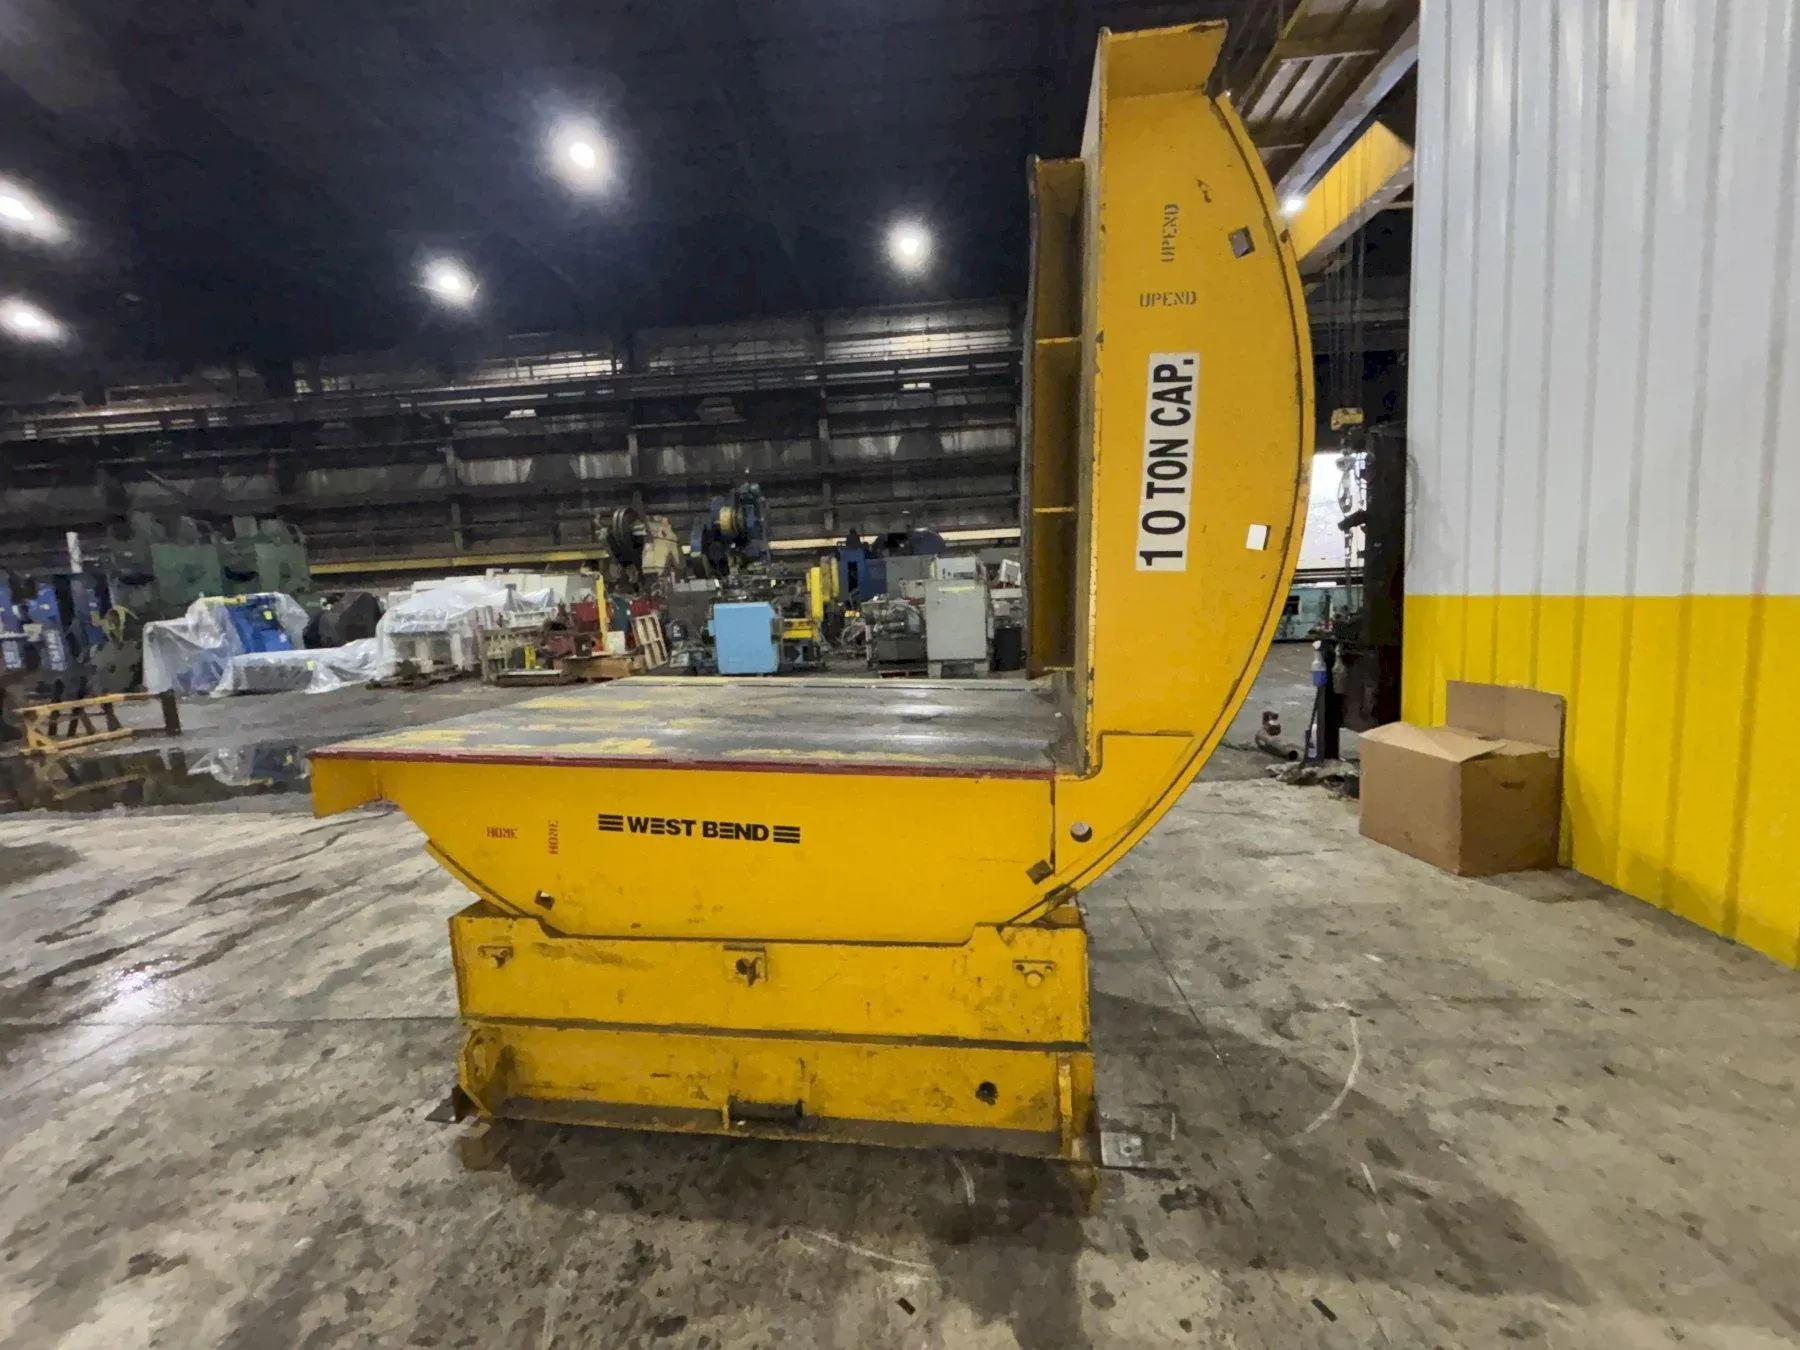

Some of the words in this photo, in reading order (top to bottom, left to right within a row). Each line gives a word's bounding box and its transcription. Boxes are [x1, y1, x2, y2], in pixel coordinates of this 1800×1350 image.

[1160, 203, 1180, 263] UPEND
[1139, 290, 1197, 307] UPEND
[1150, 358, 1195, 427] CAP.
[1145, 438, 1189, 500] TON
[1138, 509, 1187, 567] 10
[485, 826, 518, 840] HOME
[547, 819, 560, 855] HOME
[626, 815, 697, 837] WEST
[701, 820, 770, 842] BEND
